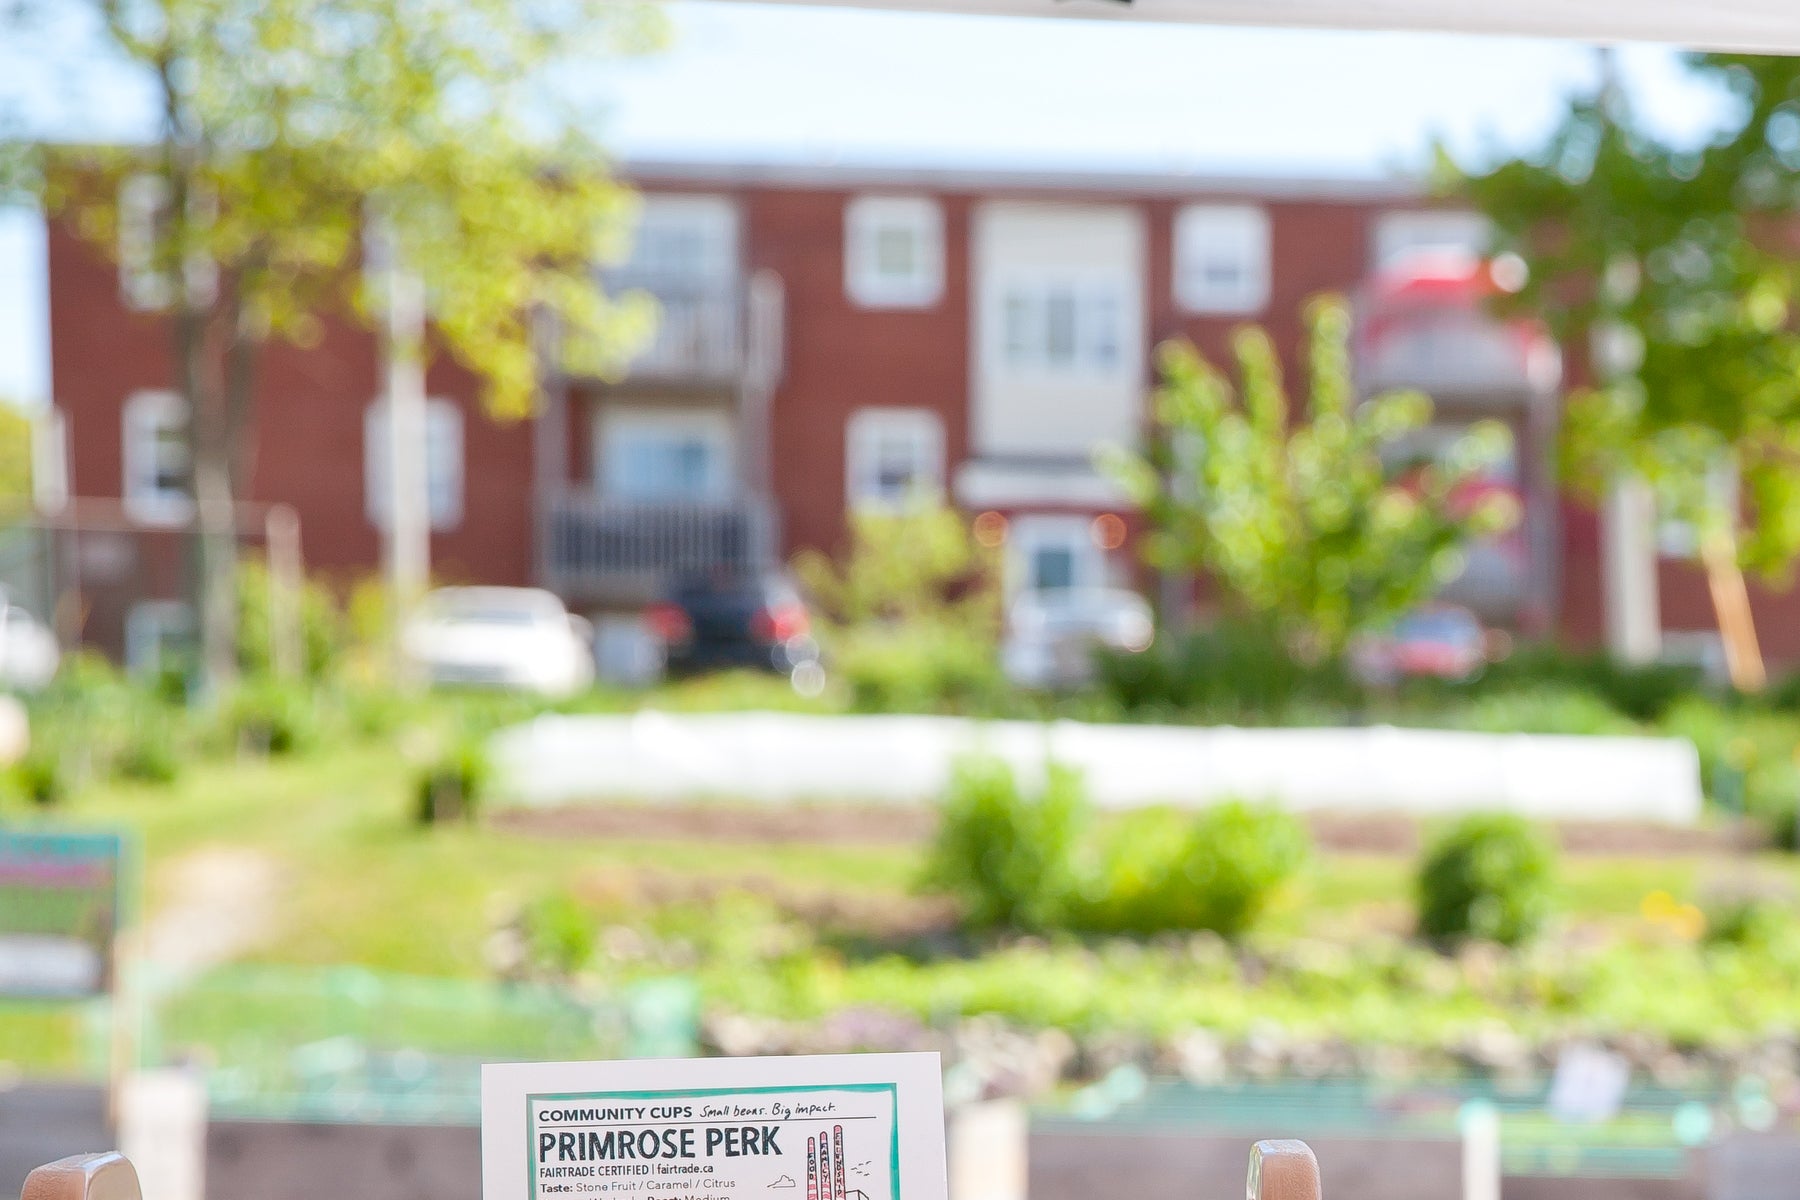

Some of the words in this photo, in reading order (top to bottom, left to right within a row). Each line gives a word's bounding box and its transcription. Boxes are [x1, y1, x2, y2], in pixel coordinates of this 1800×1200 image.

[539, 1107, 646, 1122] COMMUNITY
[650, 1106, 692, 1119] CUPS
[700, 1105, 729, 1118] Small
[733, 1105, 768, 1117] beans.
[772, 1102, 791, 1120] Big
[795, 1102, 836, 1115] impact.
[539, 1128, 696, 1163] PRIMROSE
[705, 1126, 783, 1157] PERK
[539, 1166, 600, 1178] FAIRTRADE
[600, 1164, 649, 1177] CERTIFIED
[657, 1163, 714, 1176] fairtrade.ca
[808, 1152, 816, 1180] FOOD
[540, 1183, 573, 1193] Taste:
[576, 1182, 608, 1192] Stone
[611, 1181, 636, 1191] Fruit
[646, 1179, 692, 1190] Caramel
[703, 1178, 736, 1189] Citrus
